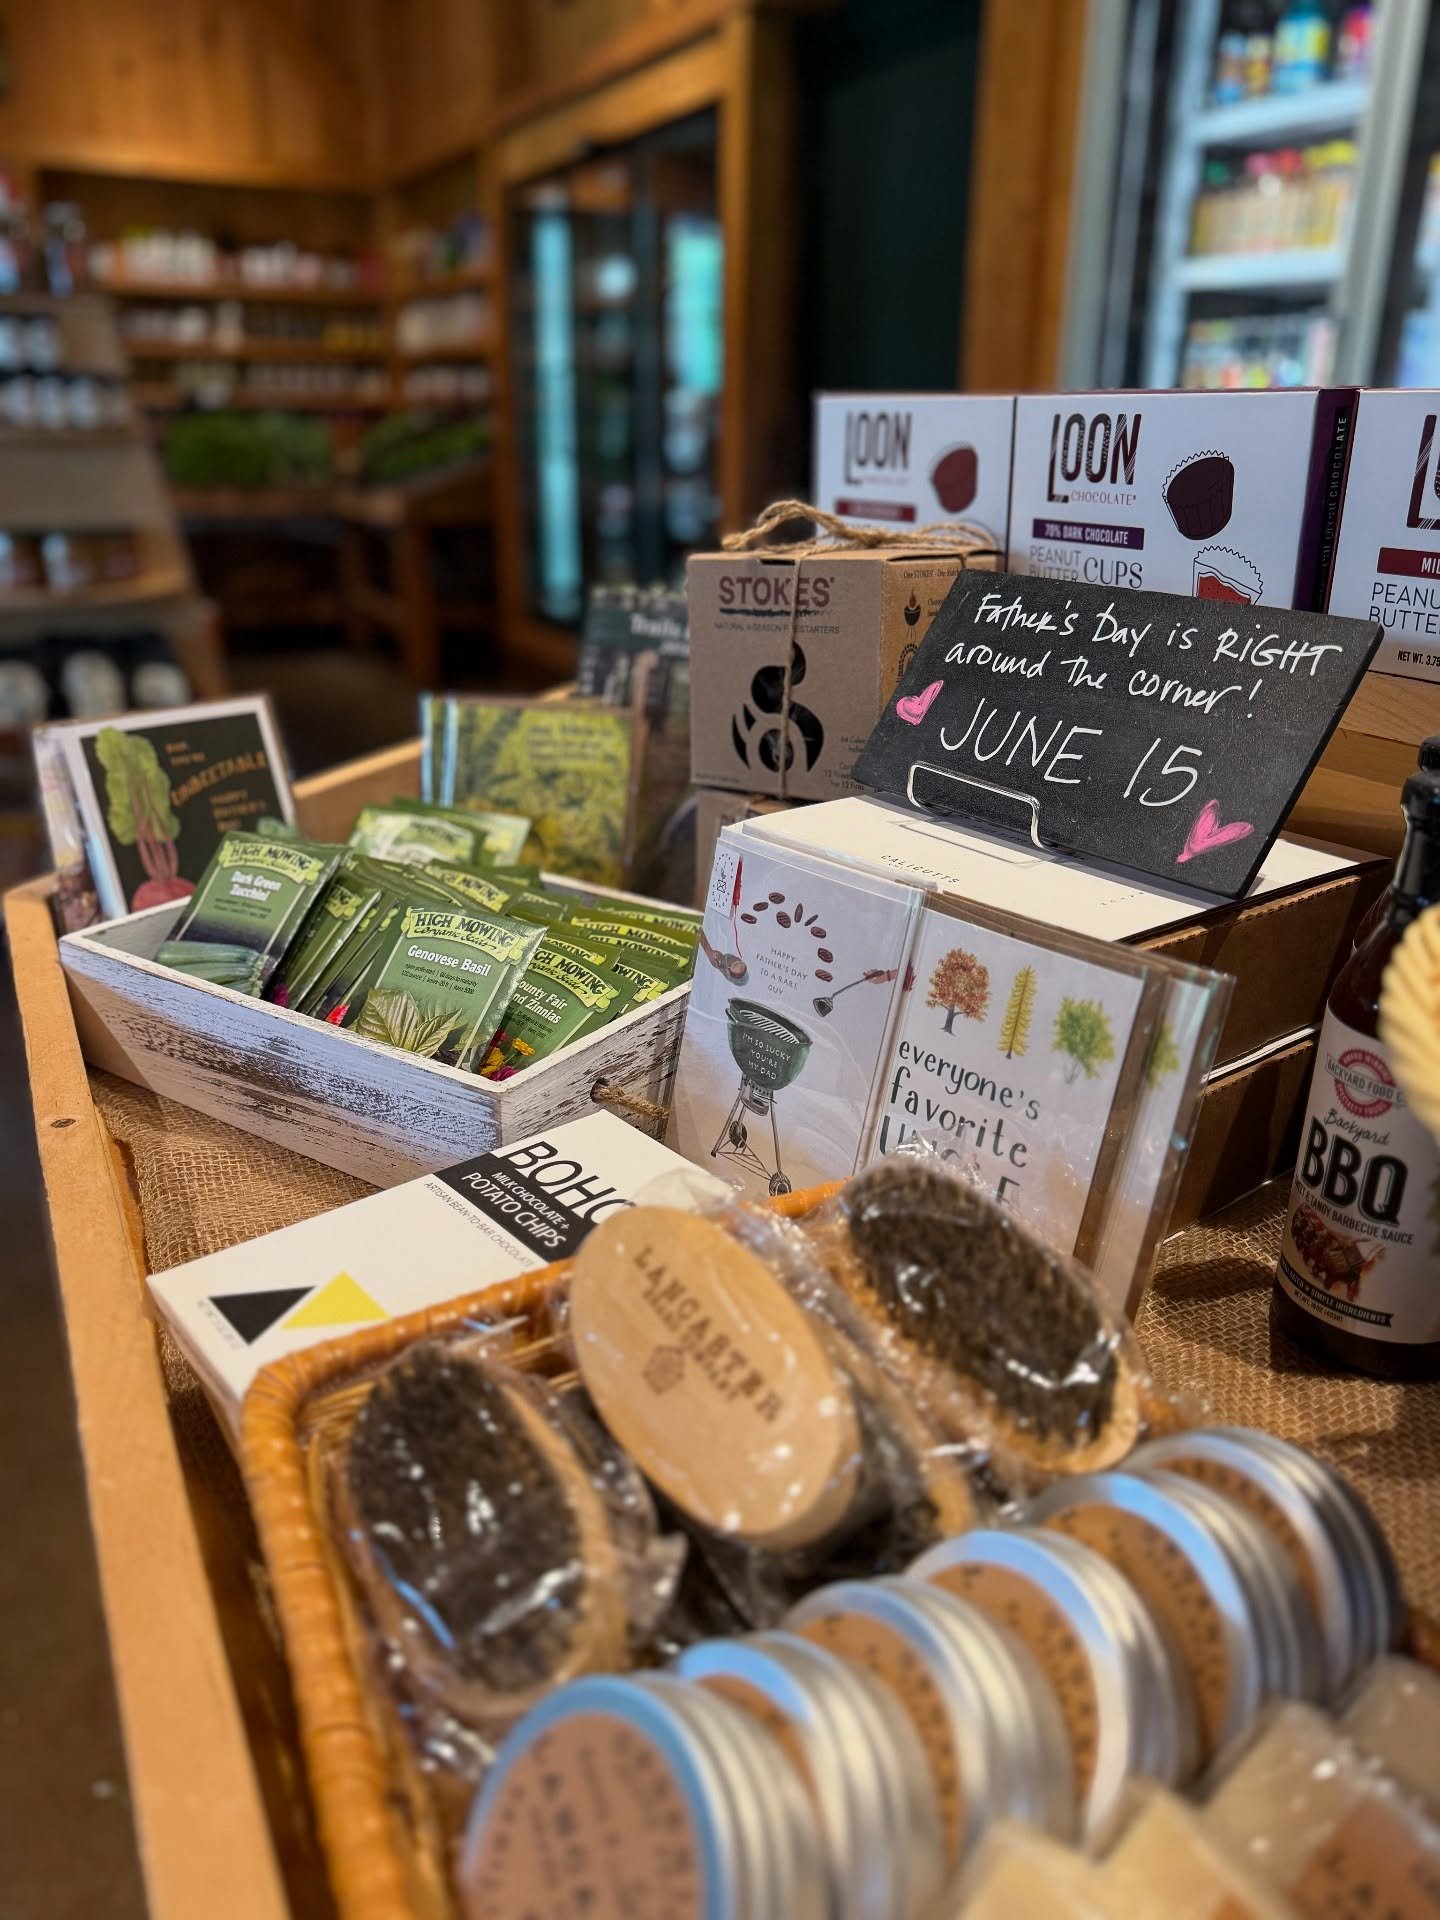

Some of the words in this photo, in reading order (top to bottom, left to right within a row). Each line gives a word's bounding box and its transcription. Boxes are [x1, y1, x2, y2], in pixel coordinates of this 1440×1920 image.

[1047, 413, 1142, 503] LOON
[1329, 417, 1347, 497] CHOCOLATE
[1044, 523, 1061, 538] 70%
[1062, 525, 1082, 540] DARK
[1084, 528, 1129, 545] CHOCOLATE
[1030, 545, 1081, 566] PEANUT
[1084, 556, 1143, 589] CUPS
[974, 593, 1079, 635] Father's
[1092, 602, 1152, 658] Day
[1166, 622, 1198, 650] is
[945, 642, 1051, 679] around
[1397, 650, 1411, 662] NET
[940, 697, 1102, 785] JUNE
[1122, 737, 1202, 808] 15
[266, 846, 313, 871] MOWING
[229, 883, 272, 901] Zucchini
[232, 870, 254, 885] Dark
[254, 874, 282, 891] Green
[414, 912, 454, 928] HIGH
[457, 917, 514, 948] MOWING
[407, 944, 460, 968] Genovese
[460, 958, 492, 977] Basil
[756, 953, 790, 974] FATHER'S
[791, 968, 808, 981] DAY
[770, 947, 796, 963] HAPPY
[555, 958, 608, 995] MOWING
[760, 967, 769, 977] TO
[770, 973, 776, 981] A
[777, 975, 798, 991] RARE
[767, 984, 784, 996] GUY
[518, 980, 548, 1001] ounty
[546, 993, 568, 1010] Fair
[524, 998, 562, 1024] Zinnias
[751, 1049, 778, 1069] YOU'RE
[755, 1039, 764, 1049] SO
[766, 1044, 791, 1062] LUCKY
[748, 1060, 759, 1072] MY
[760, 1067, 777, 1081] DAD
[899, 1040, 1041, 1120] everyone's
[1327, 1059, 1366, 1090] BACKYARD
[1368, 1081, 1394, 1099] FOOD
[890, 1066, 1027, 1168] favorite
[1323, 1107, 1391, 1146] Backyard
[1299, 1115, 1408, 1227] BBQ
[461, 1171, 522, 1214] POTATO
[515, 1210, 567, 1248] CHIPS
[491, 1171, 518, 1190] MILK
[515, 1185, 567, 1224] CHOCOLATE
[423, 1182, 453, 1204] ARTISAN
[490, 1232, 537, 1268] CHOCOLATE
[1332, 1211, 1379, 1238] BARBECUE
[1381, 1228, 1414, 1245] SAUCE
